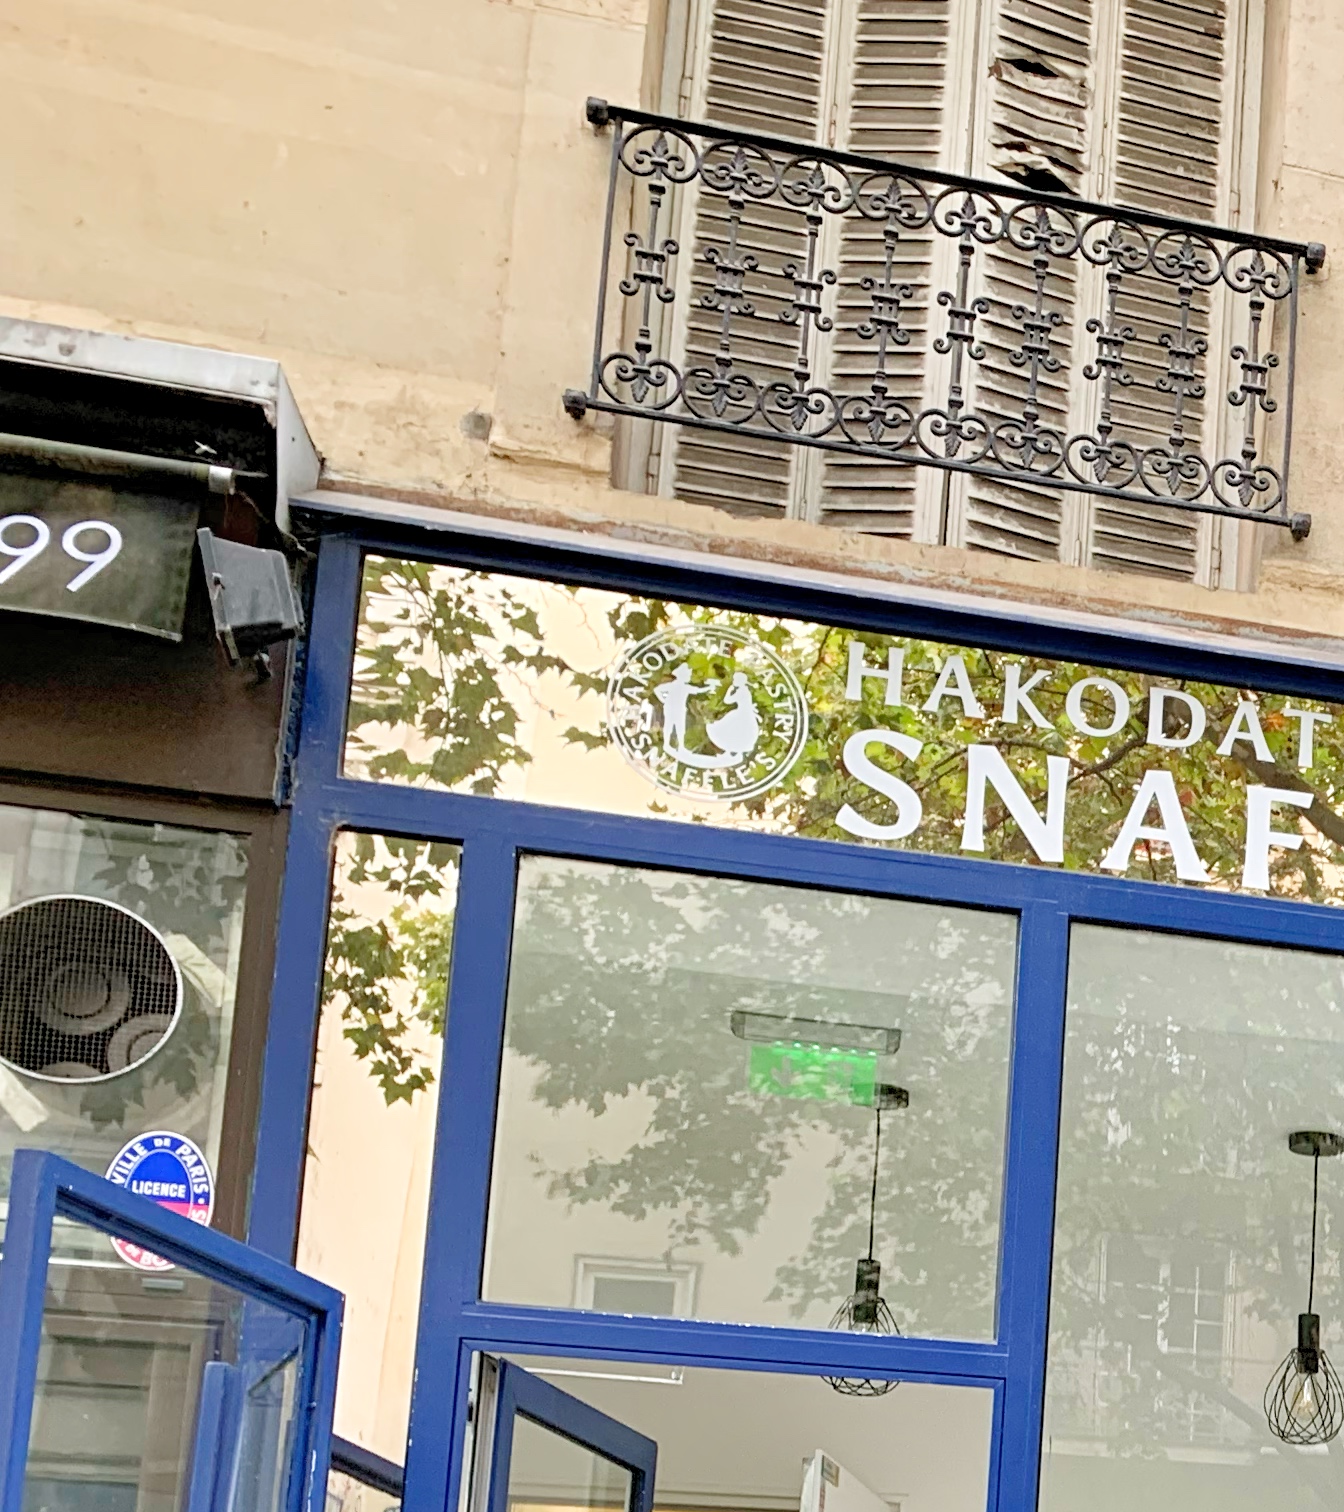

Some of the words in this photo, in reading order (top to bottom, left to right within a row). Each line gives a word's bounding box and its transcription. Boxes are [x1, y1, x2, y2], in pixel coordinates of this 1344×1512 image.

[111, 1142, 149, 1184] VILLE
[175, 1144, 209, 1194] PARIS
[131, 1180, 187, 1198] LICENCE
